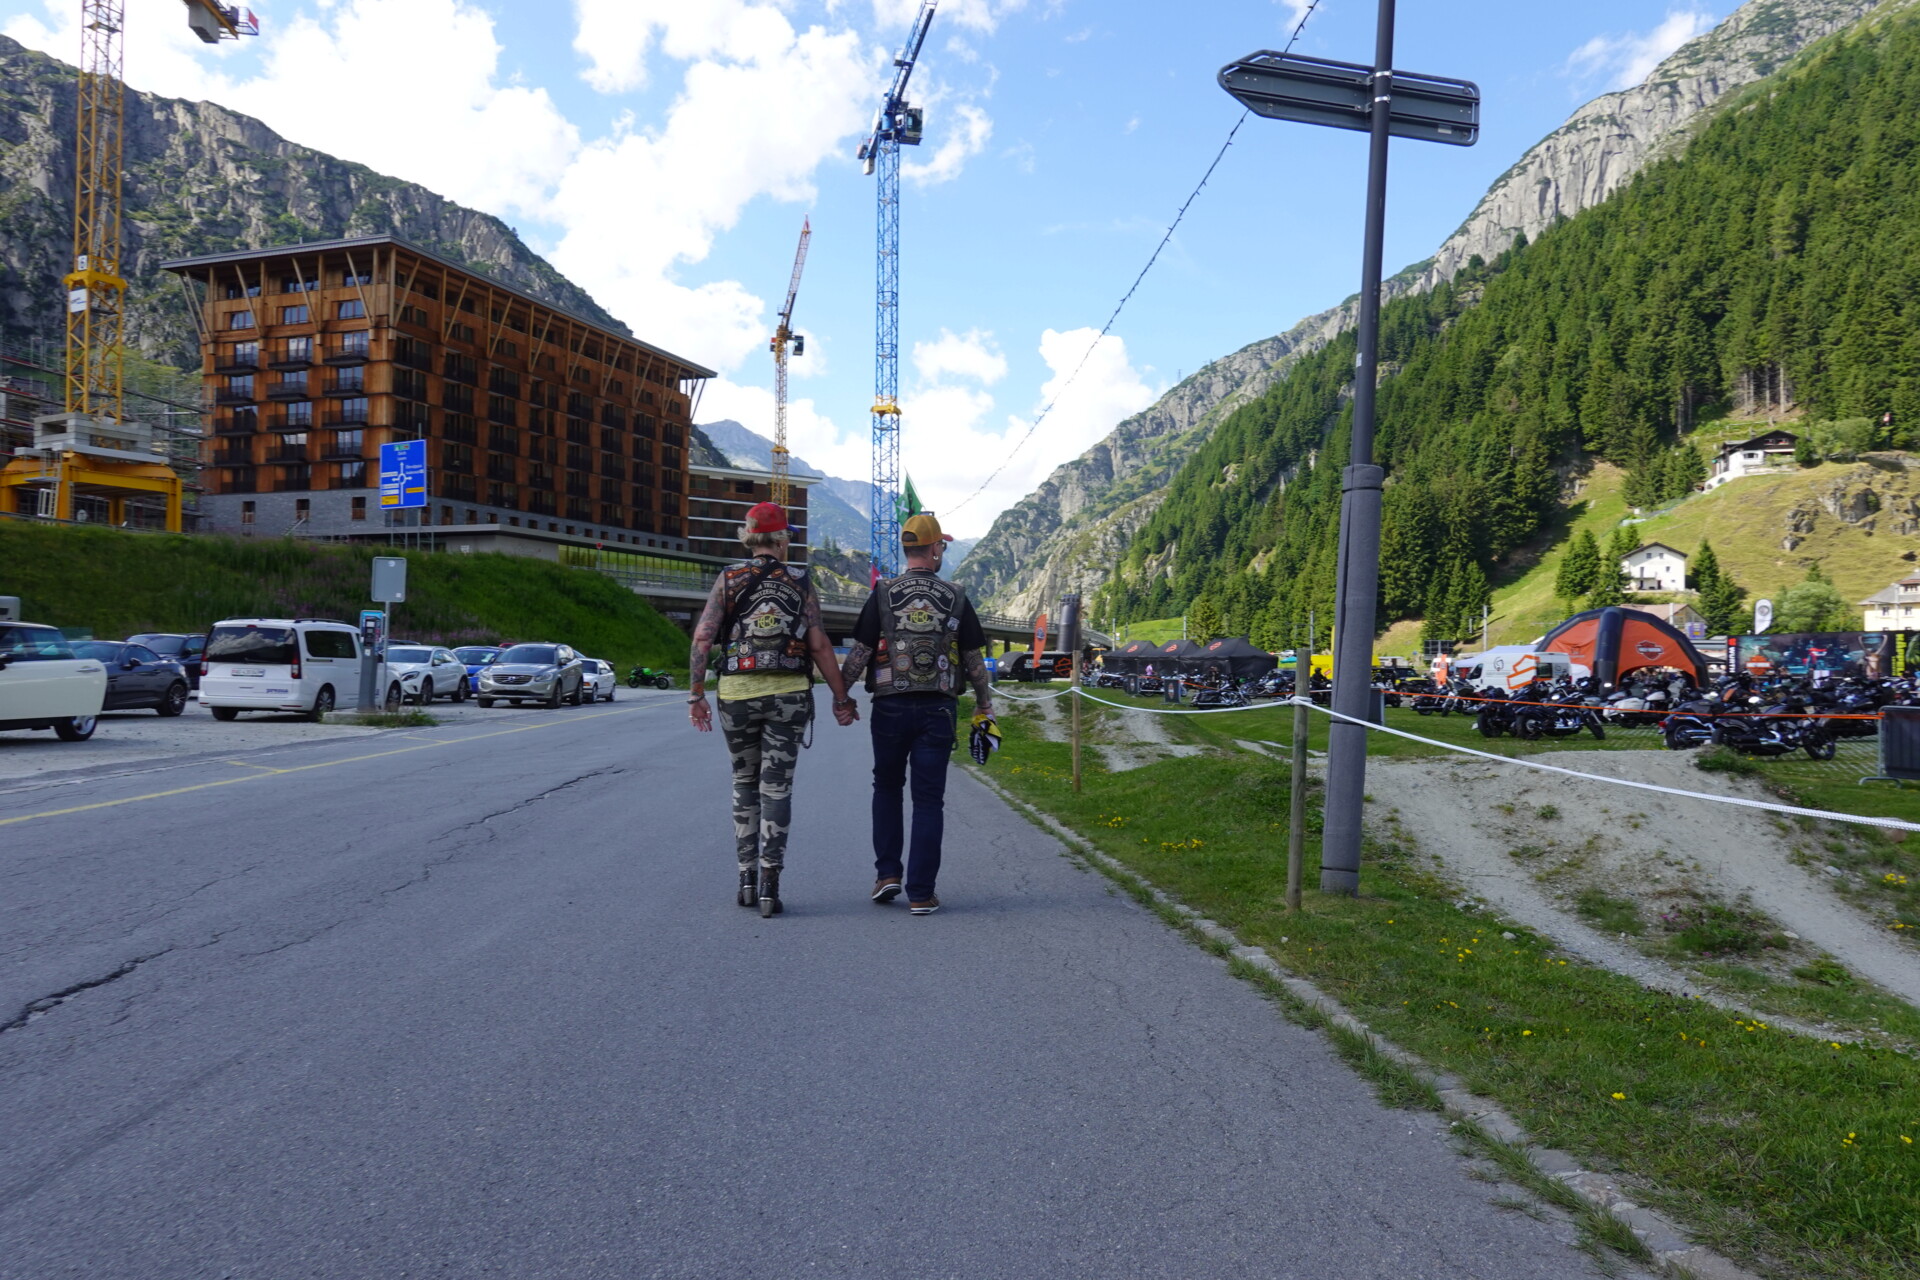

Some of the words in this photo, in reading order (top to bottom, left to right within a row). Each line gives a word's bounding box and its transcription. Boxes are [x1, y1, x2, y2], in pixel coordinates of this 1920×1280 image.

[749, 588, 789, 602] SWITZERLAND
[779, 586, 800, 602] CHAPTER
[891, 579, 917, 594] WILLIAM
[932, 583, 953, 600] CHAPTER
[902, 585, 942, 598] SWITZERLAND
